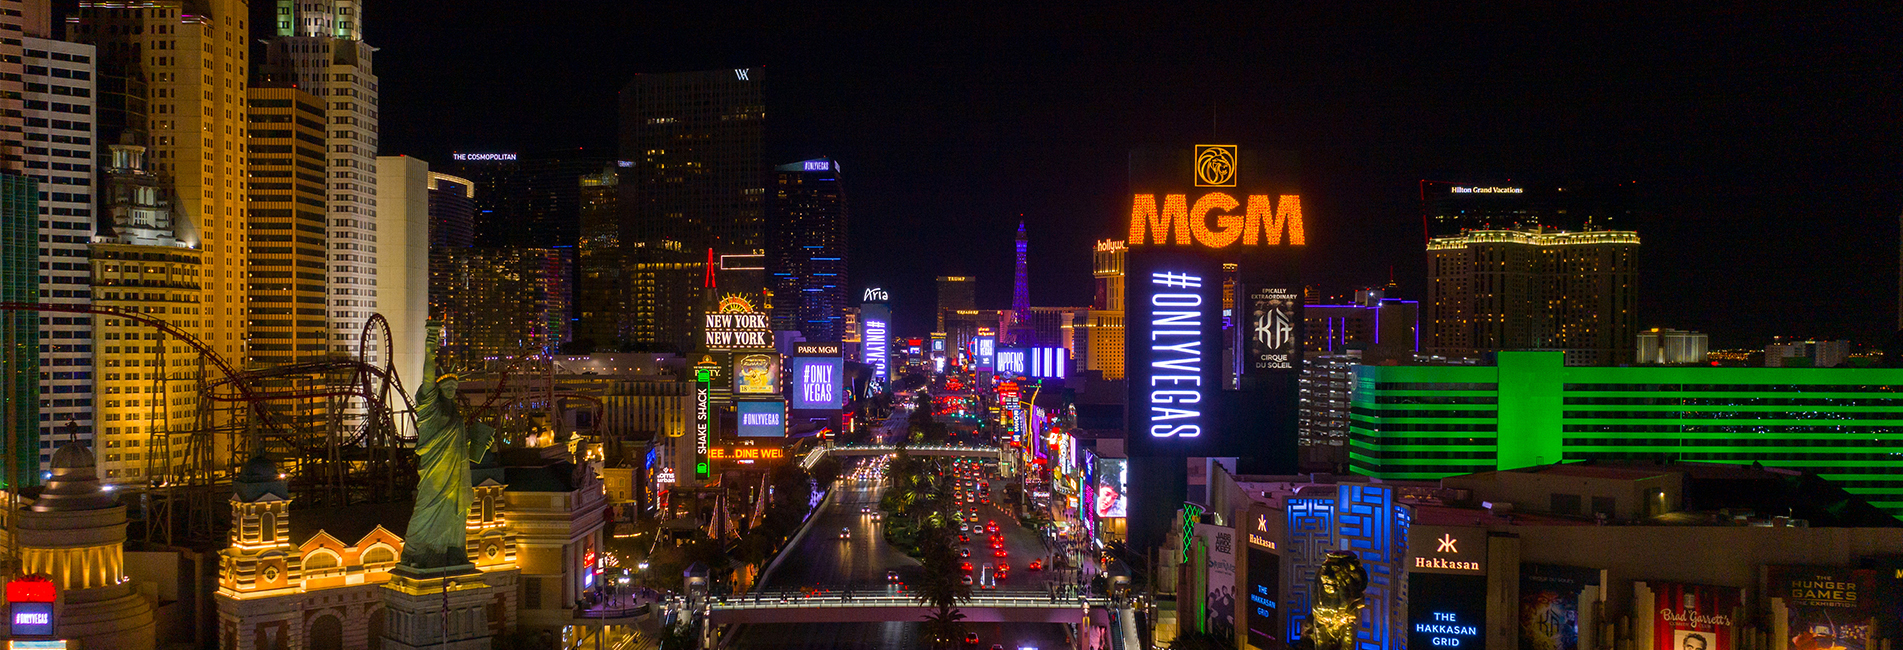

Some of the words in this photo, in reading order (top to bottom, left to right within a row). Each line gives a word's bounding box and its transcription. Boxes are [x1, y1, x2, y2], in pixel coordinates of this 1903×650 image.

[453, 153, 466, 161] THE
[467, 153, 517, 161] COSMOPOLITAN
[1451, 186, 1472, 194] Hilton
[1472, 186, 1493, 194] Grand
[1493, 186, 1523, 194] Vacations
[1128, 191, 1306, 249] MGM
[863, 287, 889, 302] Aria
[705, 314, 732, 328] NEW
[734, 314, 766, 329] YORK
[705, 331, 732, 345] NEW
[734, 331, 766, 346] YORK
[797, 346, 818, 354] PARK
[818, 346, 838, 354] MGM
[1150, 271, 1202, 438] #ONLYVEGAS
[1260, 354, 1288, 363] CIRQUE
[803, 364, 833, 383] #ONLY
[803, 383, 832, 402] VEGAS
[697, 388, 707, 420] SHACK
[742, 413, 780, 426] #ONLYVEGAS
[697, 423, 707, 455] SHAKE
[1249, 532, 1277, 550] Hakkasan
[1415, 556, 1480, 571] Hakkasan
[1257, 584, 1268, 595] THE
[1791, 580, 1857, 591] HUNGER
[1250, 593, 1276, 610] HAKKASAN
[1791, 588, 1858, 602] GAMES
[1809, 600, 1858, 608] EXHIBITION
[1433, 611, 1457, 622] THE
[1660, 607, 1687, 622] Brad
[1688, 609, 1731, 628] Garrett's
[1416, 623, 1477, 636] HAKKASAN
[1432, 636, 1460, 647] GRID
